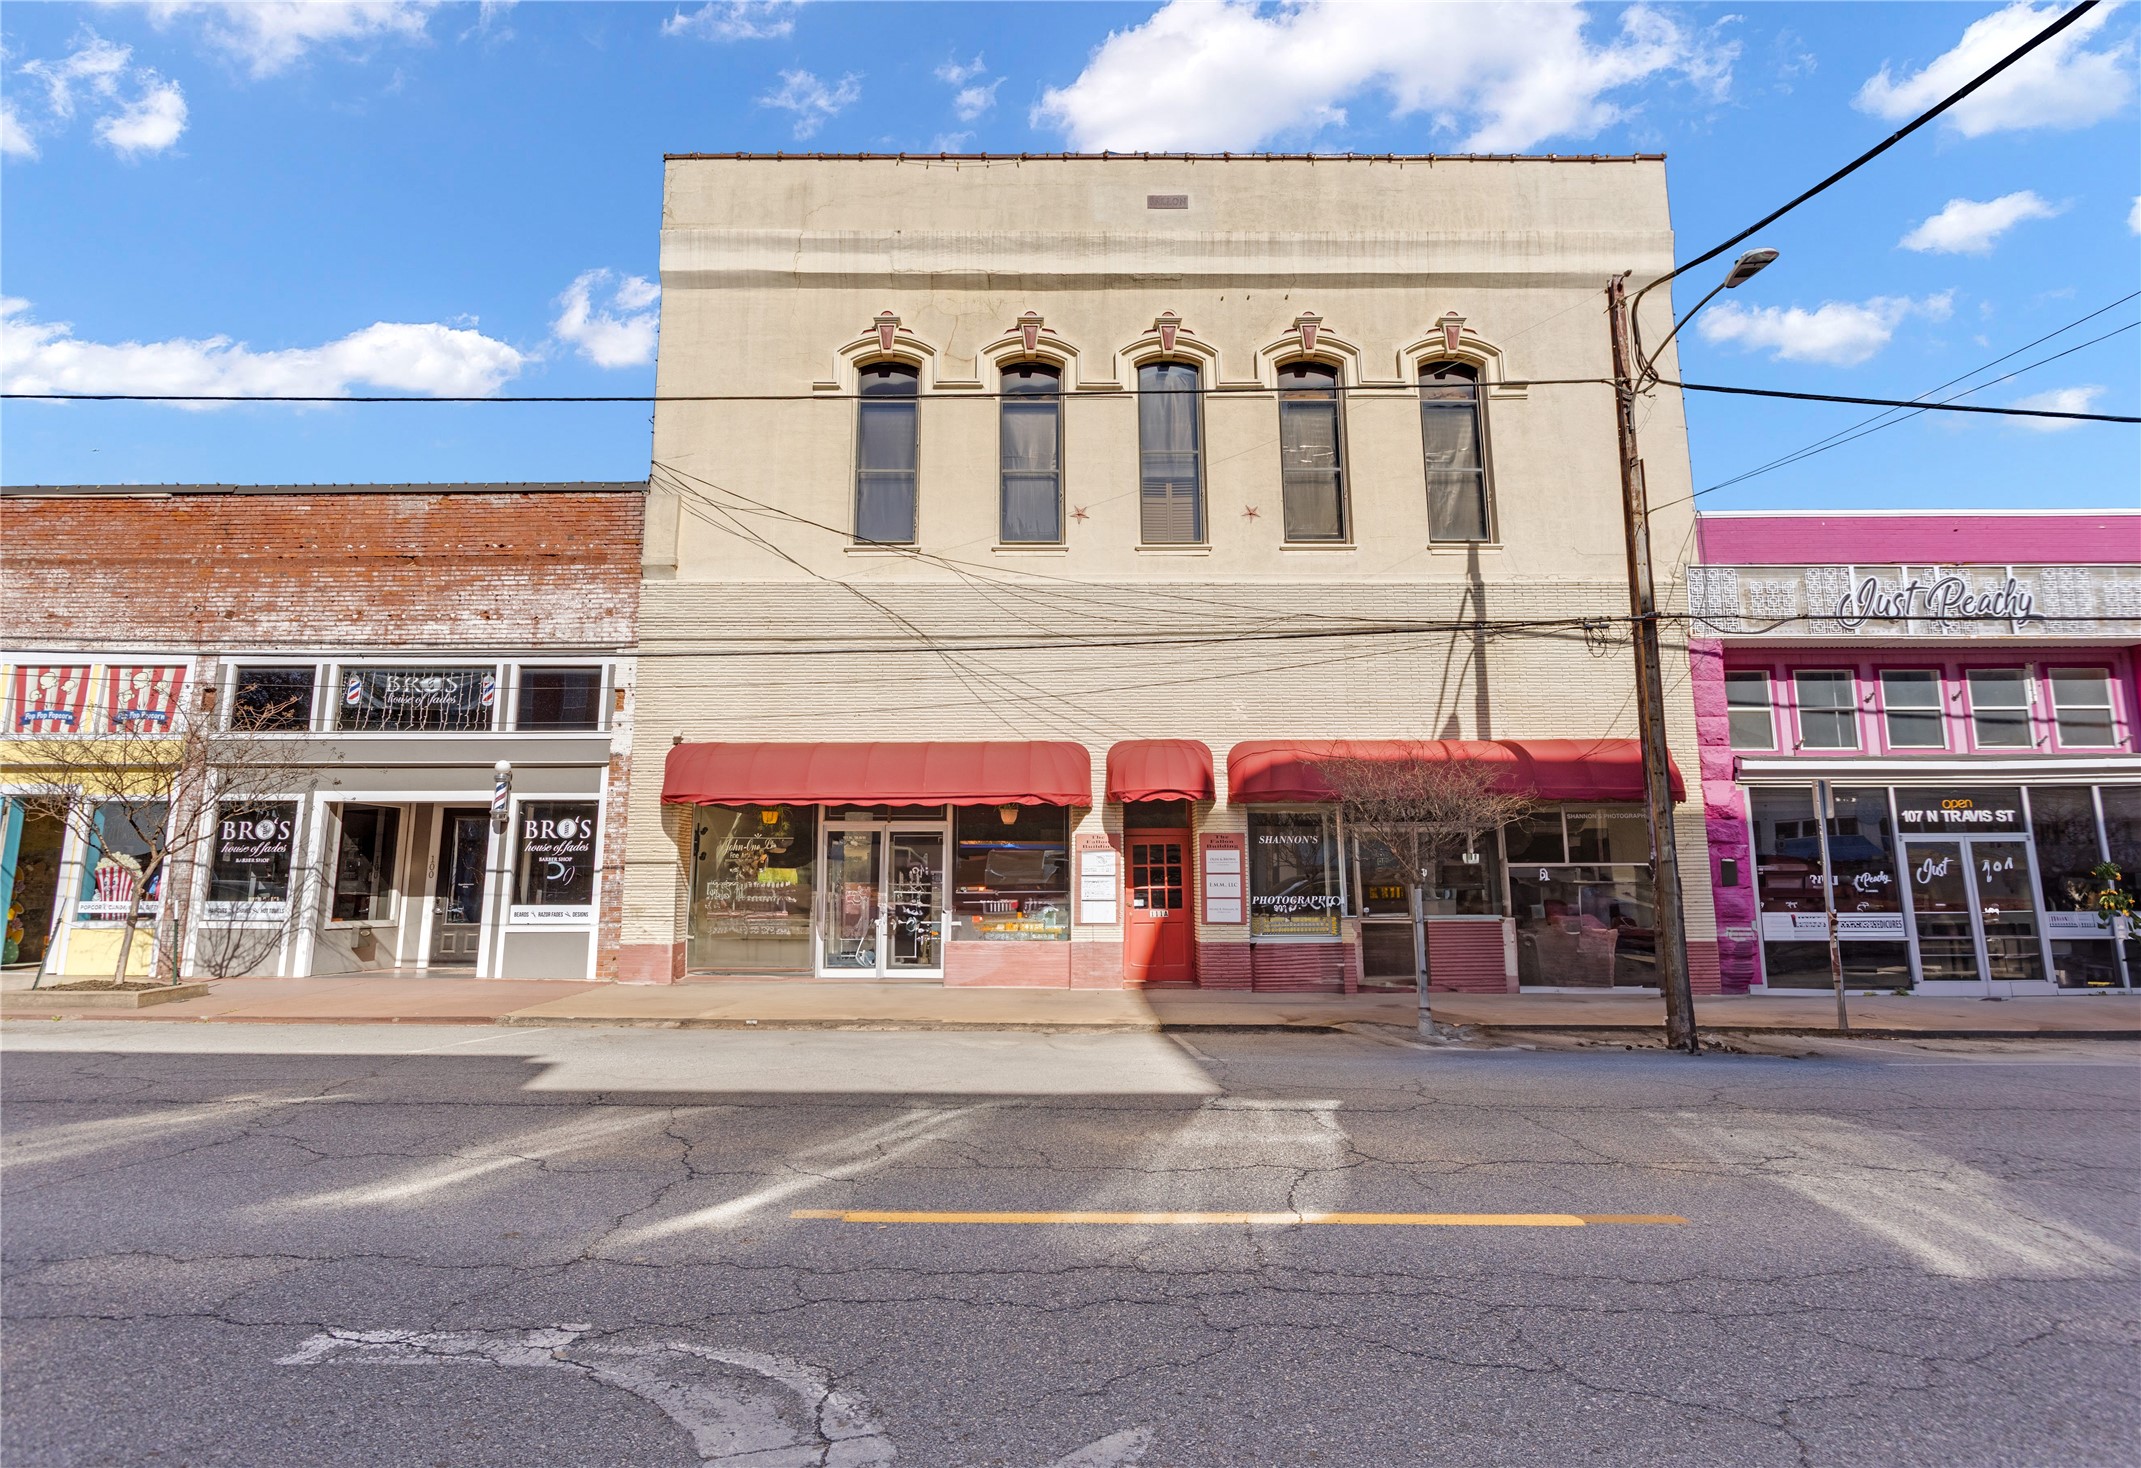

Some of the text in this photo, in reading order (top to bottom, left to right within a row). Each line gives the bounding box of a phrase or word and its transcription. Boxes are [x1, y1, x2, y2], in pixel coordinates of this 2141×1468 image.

[1836, 576, 2046, 629] Just Peachy
[387, 692, 457, 709] house of fades
[24, 712, 36, 720] Pop
[36, 711, 48, 719] Pop
[1942, 799, 1973, 810] open
[1901, 810, 2016, 822] 107 N TRAVIS ST
[221, 817, 291, 840] BRO'S
[524, 816, 592, 839] BRO'S
[524, 840, 589, 856] house of fades
[1259, 836, 1319, 844] SHANNON'S
[221, 841, 288, 858] house of fades
[1916, 857, 1954, 884] Just
